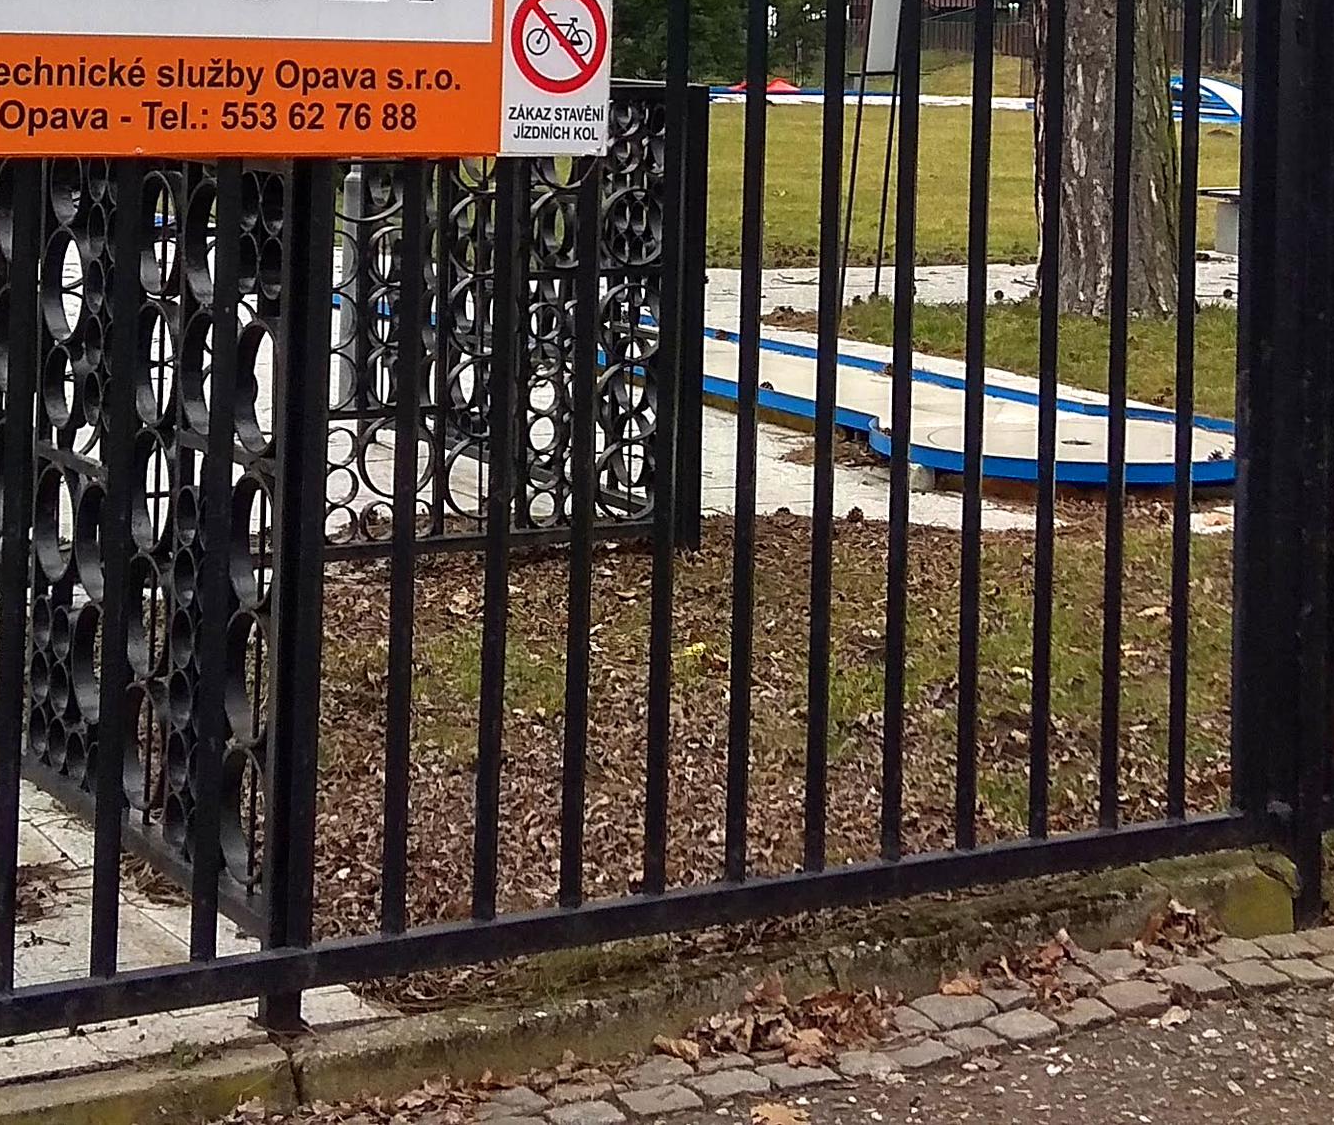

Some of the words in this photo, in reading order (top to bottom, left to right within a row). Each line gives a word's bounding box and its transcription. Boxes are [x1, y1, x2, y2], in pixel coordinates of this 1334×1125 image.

[155, 57, 265, 96] služby
[274, 59, 377, 97] Opava
[385, 67, 462, 91] s.r.o.
[141, 100, 209, 131] Tel.:
[220, 101, 278, 131] 553
[287, 102, 325, 131] 62
[335, 102, 372, 131] 76
[380, 102, 418, 131] 88
[508, 103, 552, 121] ZÁKAZ
[554, 104, 605, 122] STAVĚNÍ
[513, 122, 571, 140] JÍZDNÍCH
[573, 126, 599, 141] KOL
